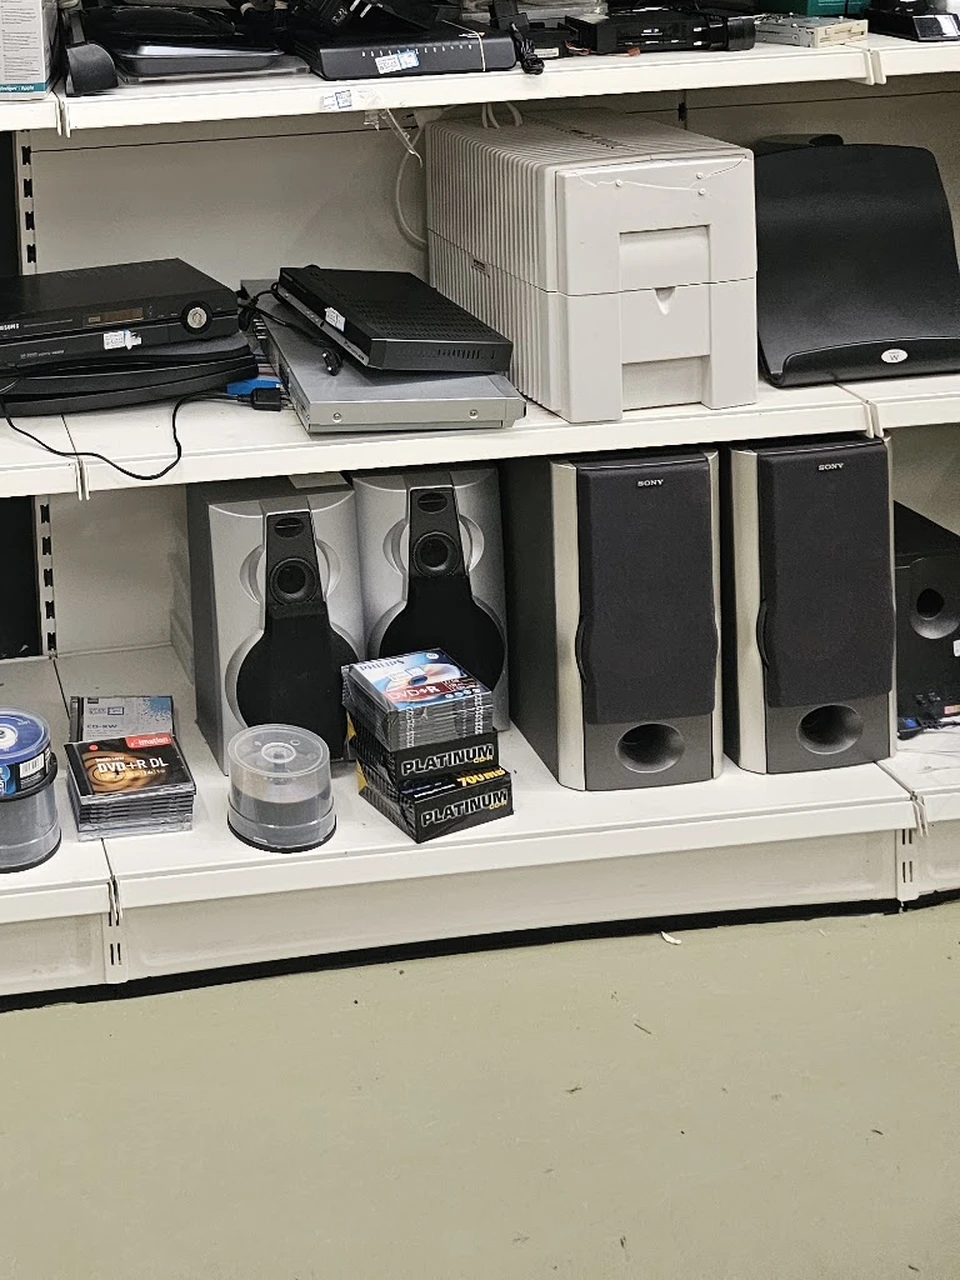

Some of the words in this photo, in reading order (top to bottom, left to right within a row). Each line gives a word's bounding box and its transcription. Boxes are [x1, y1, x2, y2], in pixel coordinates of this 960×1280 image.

[818, 462, 844, 471] SONY
[637, 479, 664, 487] SONY
[359, 659, 405, 671] PHILIPS
[386, 684, 441, 700] DVD+R
[96, 759, 147, 773] DVD+R
[149, 757, 169, 768] DL
[401, 743, 495, 776] PLATINUM
[421, 788, 509, 828] PLATINUM
